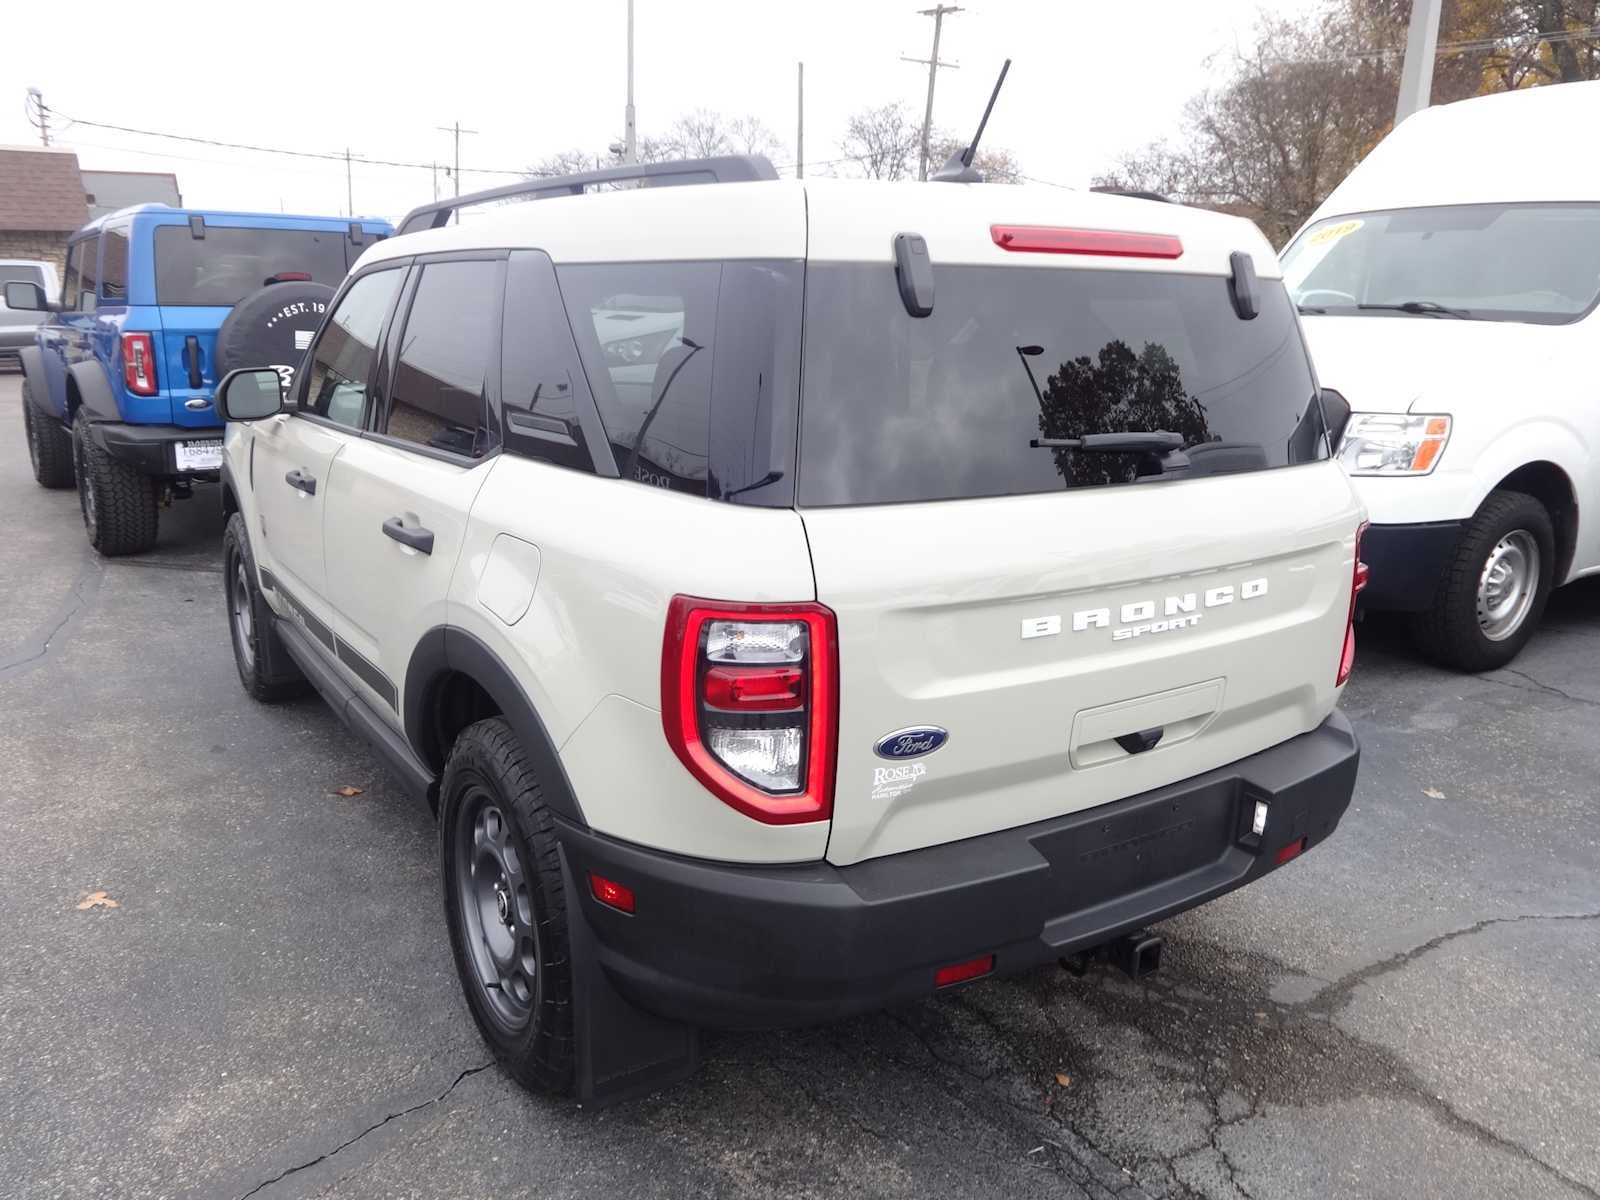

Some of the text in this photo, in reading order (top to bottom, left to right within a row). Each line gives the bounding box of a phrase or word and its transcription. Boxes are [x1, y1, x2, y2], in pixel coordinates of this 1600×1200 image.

[283, 302, 309, 317] EST.
[1021, 577, 1268, 639] BRONCO
[1112, 613, 1203, 641] SPORT
[893, 733, 935, 755] Ford
[873, 765, 910, 786] ROSE
